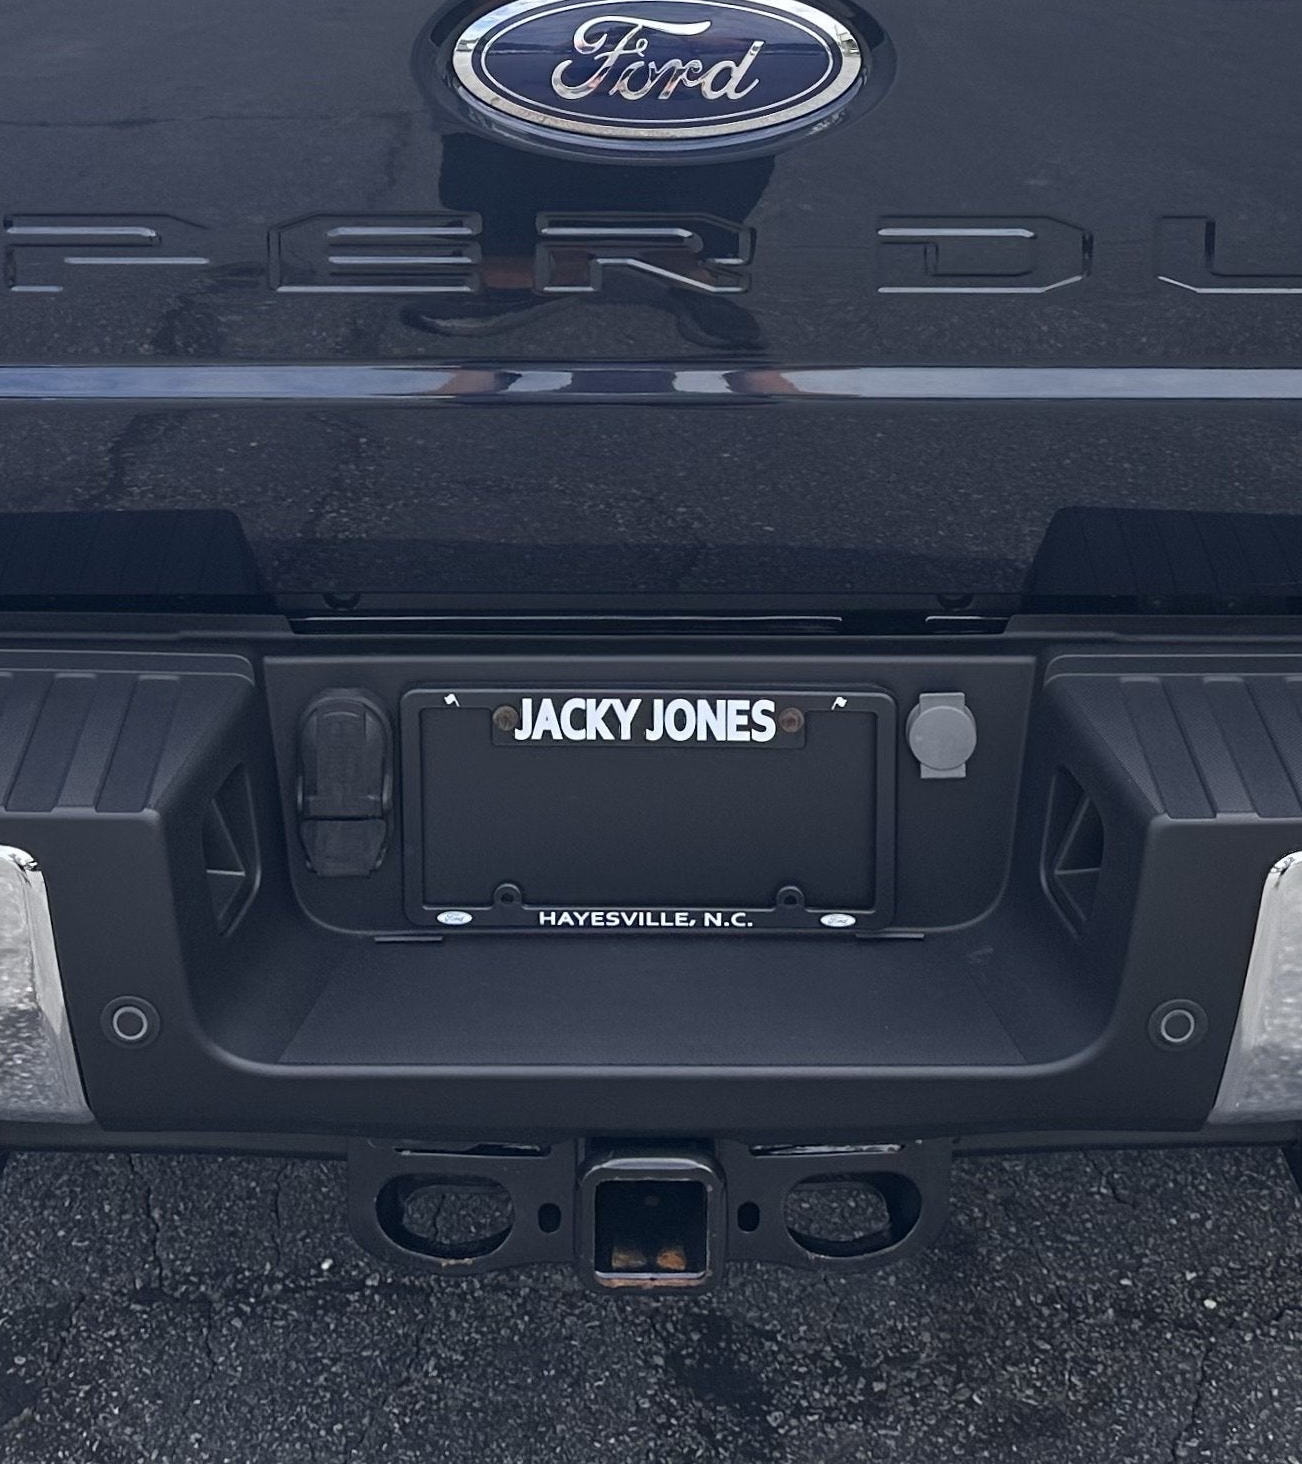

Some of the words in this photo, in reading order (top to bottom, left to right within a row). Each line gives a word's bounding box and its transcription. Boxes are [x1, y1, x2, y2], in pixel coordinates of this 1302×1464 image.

[552, 15, 765, 101] Ford
[514, 697, 642, 741] JACKY
[645, 698, 777, 743] JONES
[538, 911, 696, 927] HAYESVILLE,
[703, 912, 753, 927] N.C.
